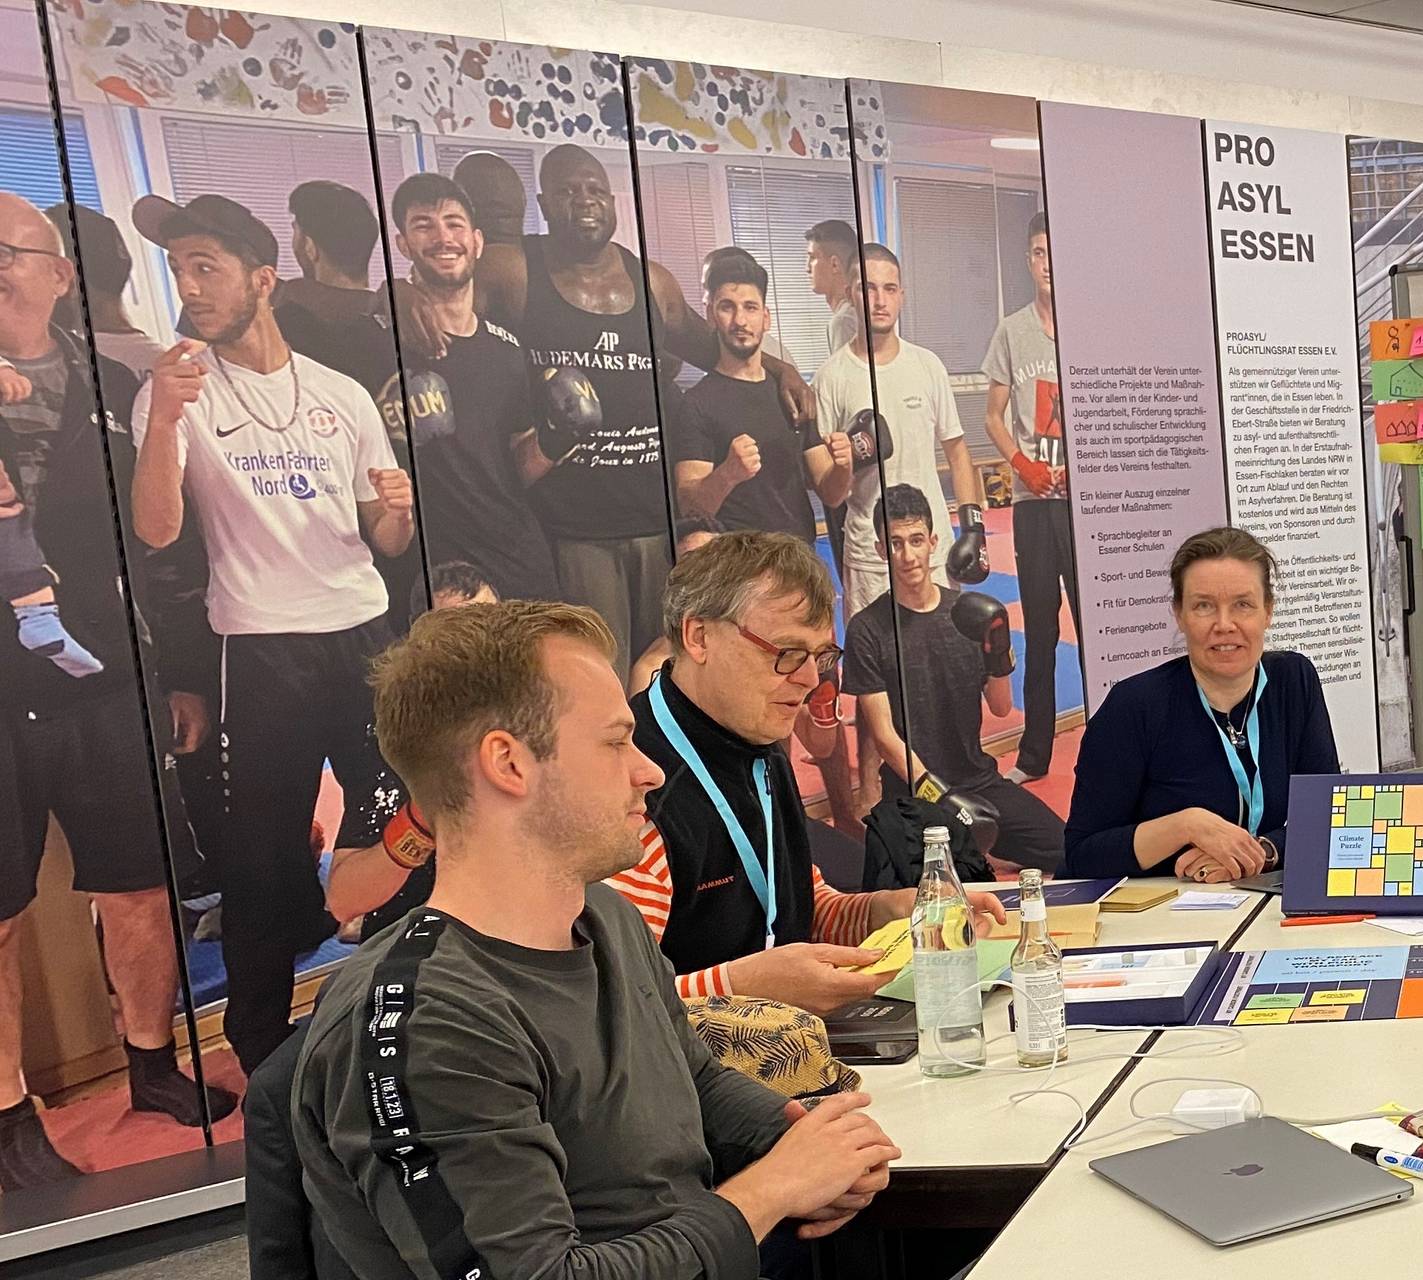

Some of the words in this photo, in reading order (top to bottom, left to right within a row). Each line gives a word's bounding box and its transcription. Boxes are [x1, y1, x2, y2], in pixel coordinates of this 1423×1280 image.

[1214, 132, 1275, 167] PRO
[1217, 181, 1292, 215] ASYL
[1220, 229, 1315, 263] ESSEN
[594, 331, 619, 351] AP
[1227, 344, 1296, 355] FLÜCHTLINGSRAT
[1298, 346, 1322, 355] ESSEN
[1325, 347, 1338, 355] E.V.
[1014, 359, 1057, 386] MUHA
[1069, 366, 1099, 375] Derzeit
[1101, 366, 1136, 375] unterhält
[1139, 367, 1152, 375] der
[1154, 366, 1177, 375] Verein
[1180, 367, 1202, 375] unter-
[1229, 367, 1240, 375] Als
[1242, 368, 1297, 377] gemeinnütziger
[1298, 367, 1319, 375] Verein
[1071, 380, 1117, 389] schiedliche
[1120, 380, 1152, 391] Projekte
[1154, 381, 1169, 389] und
[1171, 380, 1205, 389] Maßnah-
[1230, 380, 1256, 389] stützen
[1258, 380, 1269, 388] wir
[1271, 380, 1311, 388] Geflüchtete
[1312, 380, 1325, 388] und
[1327, 380, 1342, 390] Mig-
[1089, 394, 1103, 403] Vor
[1105, 394, 1127, 403] allem
[1129, 394, 1136, 403] in
[1138, 394, 1152, 403] der
[1154, 394, 1181, 403] Kinder-
[1184, 394, 1198, 402] und
[1271, 393, 1282, 401] die
[1284, 393, 1290, 401] in
[1073, 408, 1129, 419] Jugendarbeit,
[1131, 407, 1172, 418] Förderung
[1174, 407, 1207, 418] sprachli-
[1231, 406, 1244, 415] der
[1245, 406, 1300, 415] Geschäftsstelle
[1309, 405, 1321, 413] der
[1322, 405, 1354, 413] Friedrich-
[1074, 423, 1093, 432] cher
[1095, 422, 1111, 431] und
[1113, 421, 1158, 430] schulischer
[1160, 421, 1206, 431] Entwicklung
[1232, 419, 1278, 428] Ebert-Straße
[1280, 419, 1301, 427] bieten
[1303, 418, 1313, 426] wir
[1315, 418, 1346, 427] Beratung
[1075, 437, 1087, 446] als
[1090, 436, 1110, 445] auch
[1112, 436, 1122, 444] im
[1124, 434, 1204, 446] sportpädagogischen
[224, 449, 285, 471] Kranken
[1076, 450, 1108, 460] Bereich
[1110, 449, 1136, 458] lassen
[1138, 448, 1154, 457] sich
[1156, 448, 1168, 457] die
[1078, 464, 1101, 473] felder
[1103, 463, 1119, 472] des
[1120, 462, 1149, 472] Vereins
[1152, 461, 1192, 470] festhalten.
[252, 475, 288, 496] Nord
[1080, 491, 1093, 501] Ein
[1095, 490, 1122, 500] kleiner
[1124, 489, 1154, 500] Auszug
[1156, 488, 1190, 497] einzelner
[1081, 505, 1119, 515] laufender
[1122, 502, 1172, 513] Maßnahmen:
[1097, 529, 1160, 542] Sprachbegleiter
[1162, 529, 1172, 537] an
[1099, 544, 1130, 555] Essener
[1133, 542, 1164, 552] Schulen
[1101, 572, 1126, 583] Sport-
[1128, 570, 1144, 580] und
[1145, 568, 1170, 578] Bewe
[1103, 600, 1114, 609] Fit
[1115, 598, 1126, 607] für
[1105, 622, 1167, 635] Ferienangebote
[1107, 650, 1149, 662] Lerncoach
[1151, 649, 1161, 657] an
[1163, 646, 1187, 656] Essen
